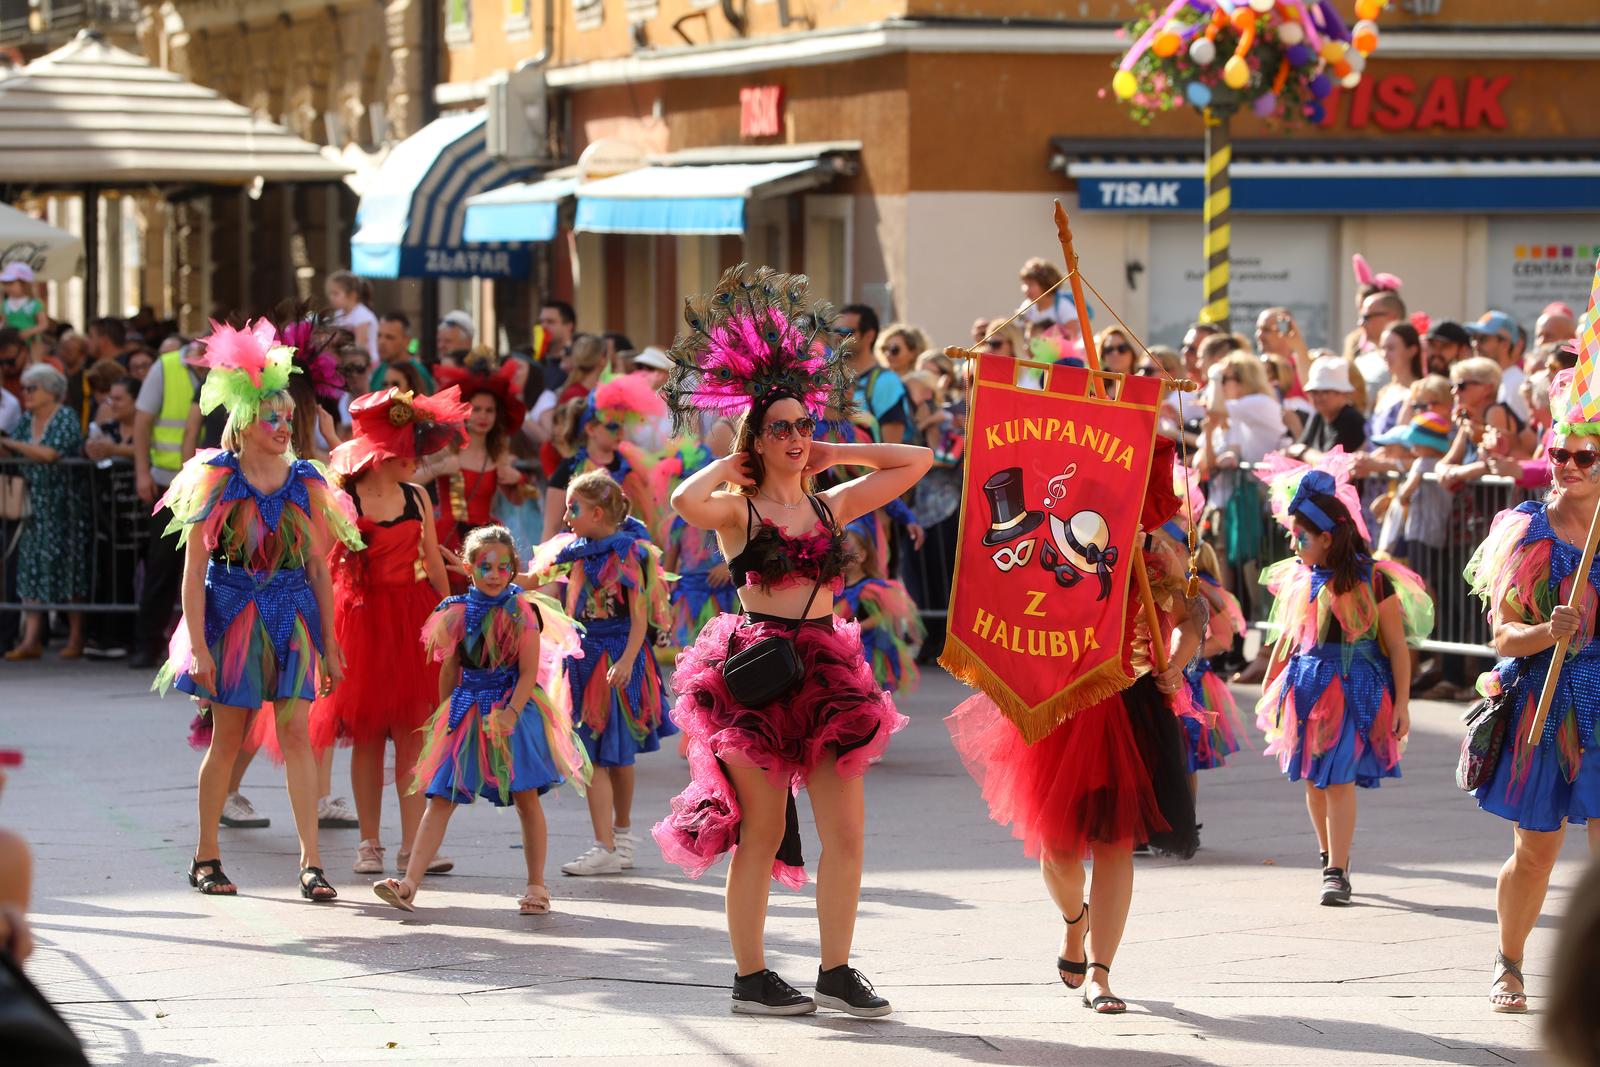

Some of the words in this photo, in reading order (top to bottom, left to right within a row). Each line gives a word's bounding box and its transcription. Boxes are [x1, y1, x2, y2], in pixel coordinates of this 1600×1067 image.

[1098, 181, 1180, 206] TISAK
[984, 417, 1136, 472] KUNPANIJA
[1023, 590, 1047, 617] Z
[972, 607, 1102, 663] HALUBJA
